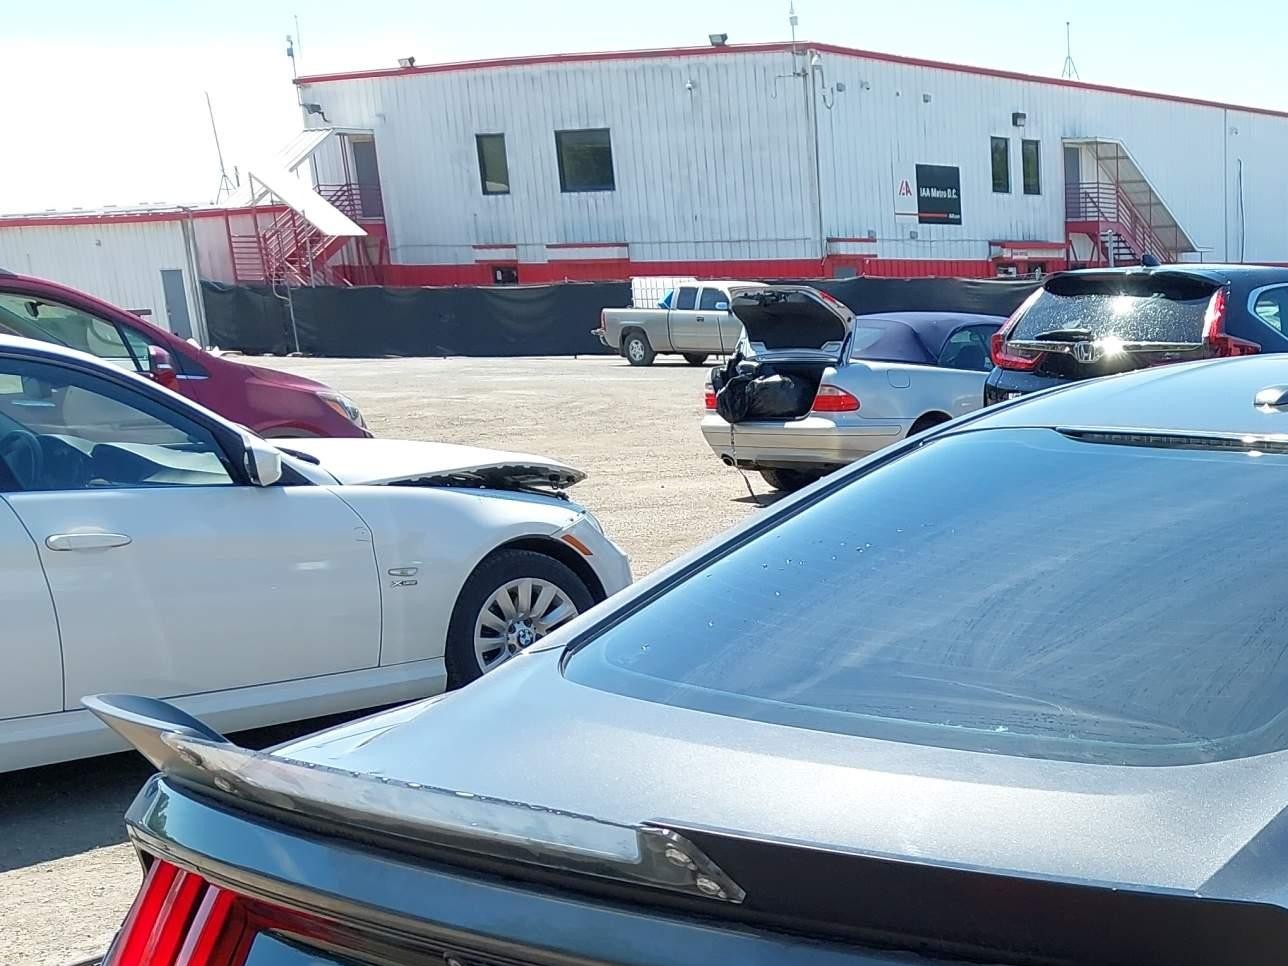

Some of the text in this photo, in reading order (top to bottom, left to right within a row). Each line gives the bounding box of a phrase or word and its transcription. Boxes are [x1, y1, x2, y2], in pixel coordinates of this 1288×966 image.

[920, 187, 959, 199] IAA Metro D.C.
